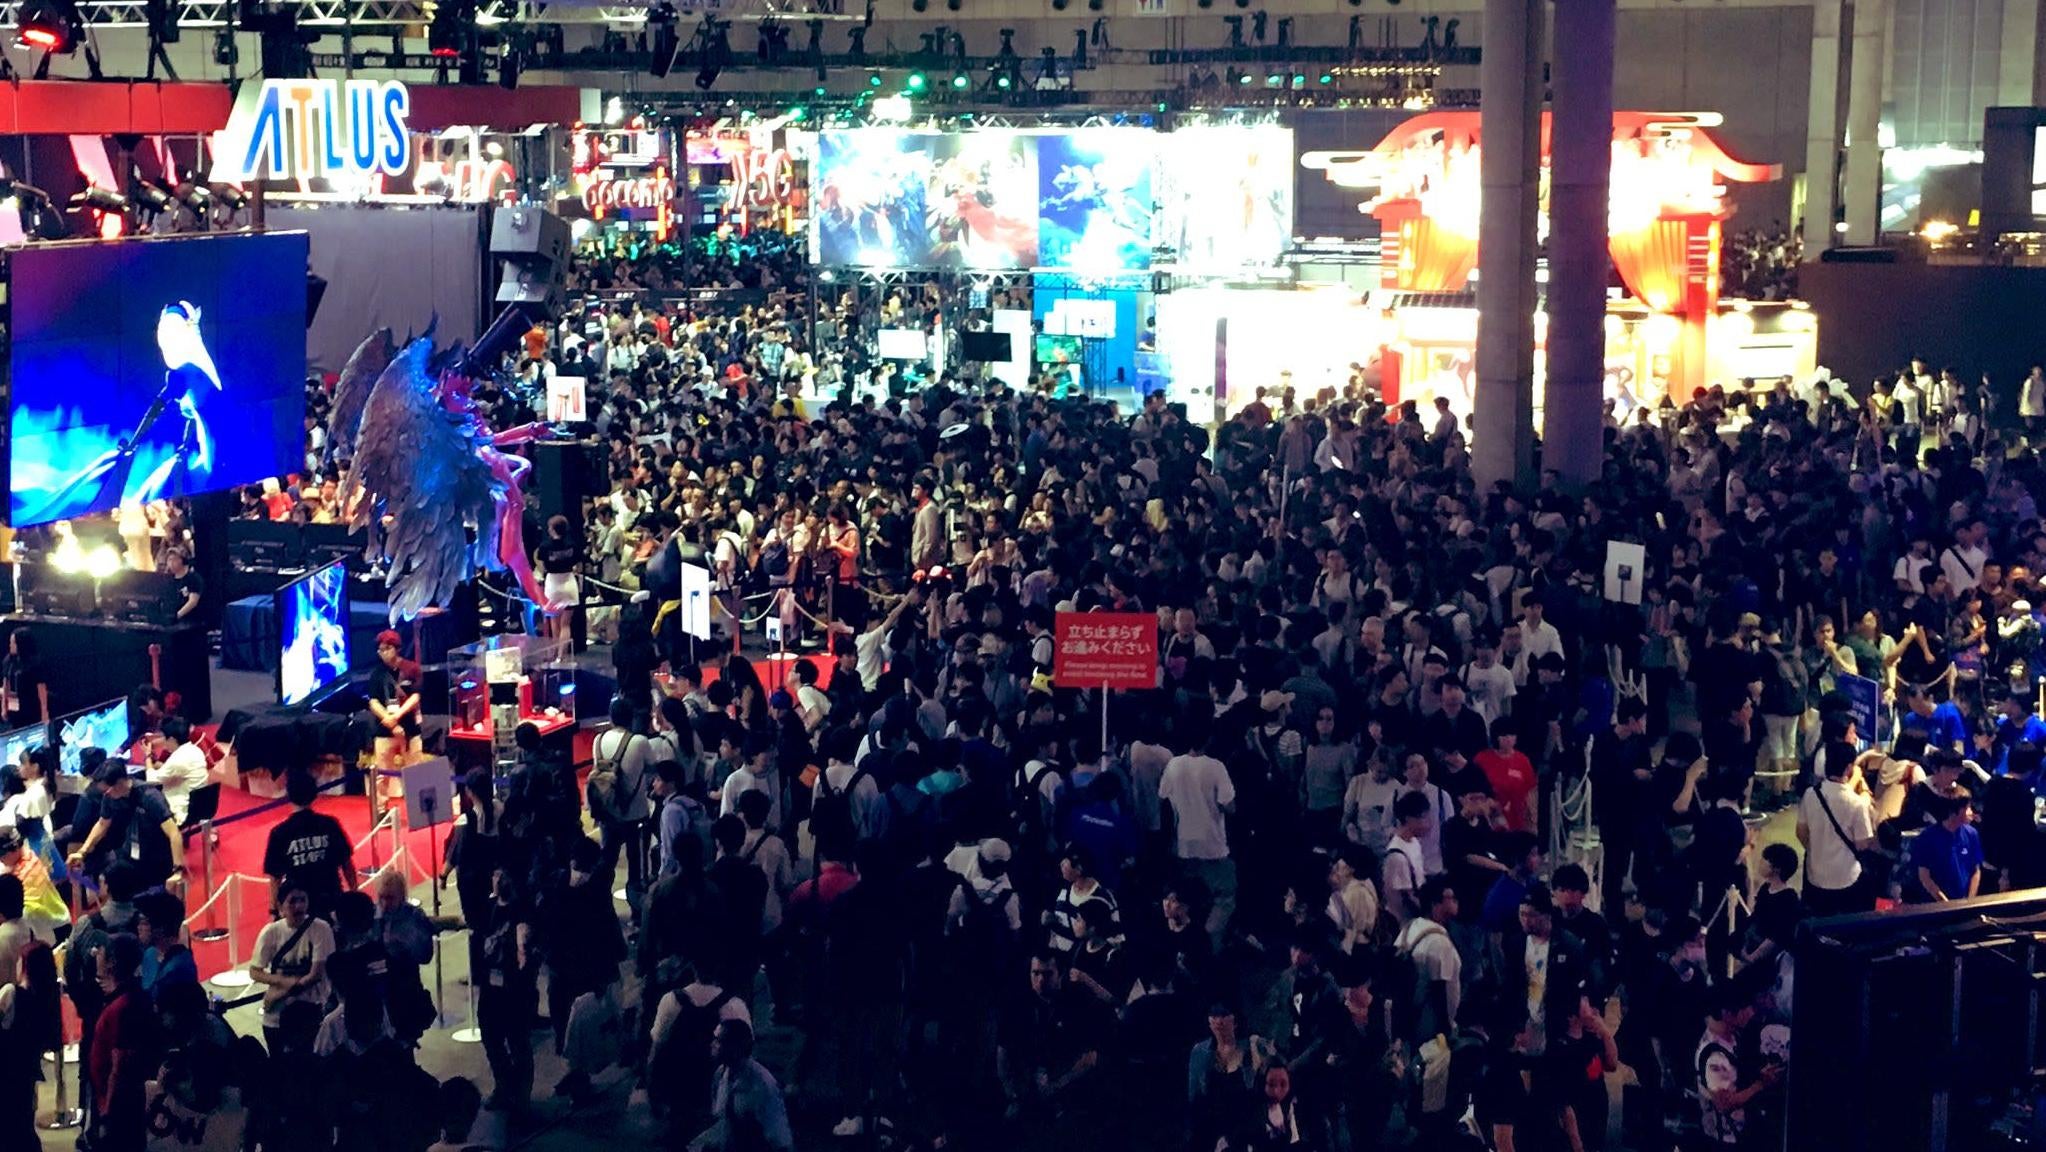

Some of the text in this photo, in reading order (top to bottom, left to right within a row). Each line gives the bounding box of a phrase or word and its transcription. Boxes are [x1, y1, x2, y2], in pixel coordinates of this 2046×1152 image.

[232, 82, 407, 177] ATLUS
[581, 170, 675, 211] docomo
[1067, 624, 1144, 641] 立ち止まらず
[1060, 641, 1152, 655] お進みください
[286, 834, 329, 855] ATLUS
[291, 849, 327, 867] STAFF
